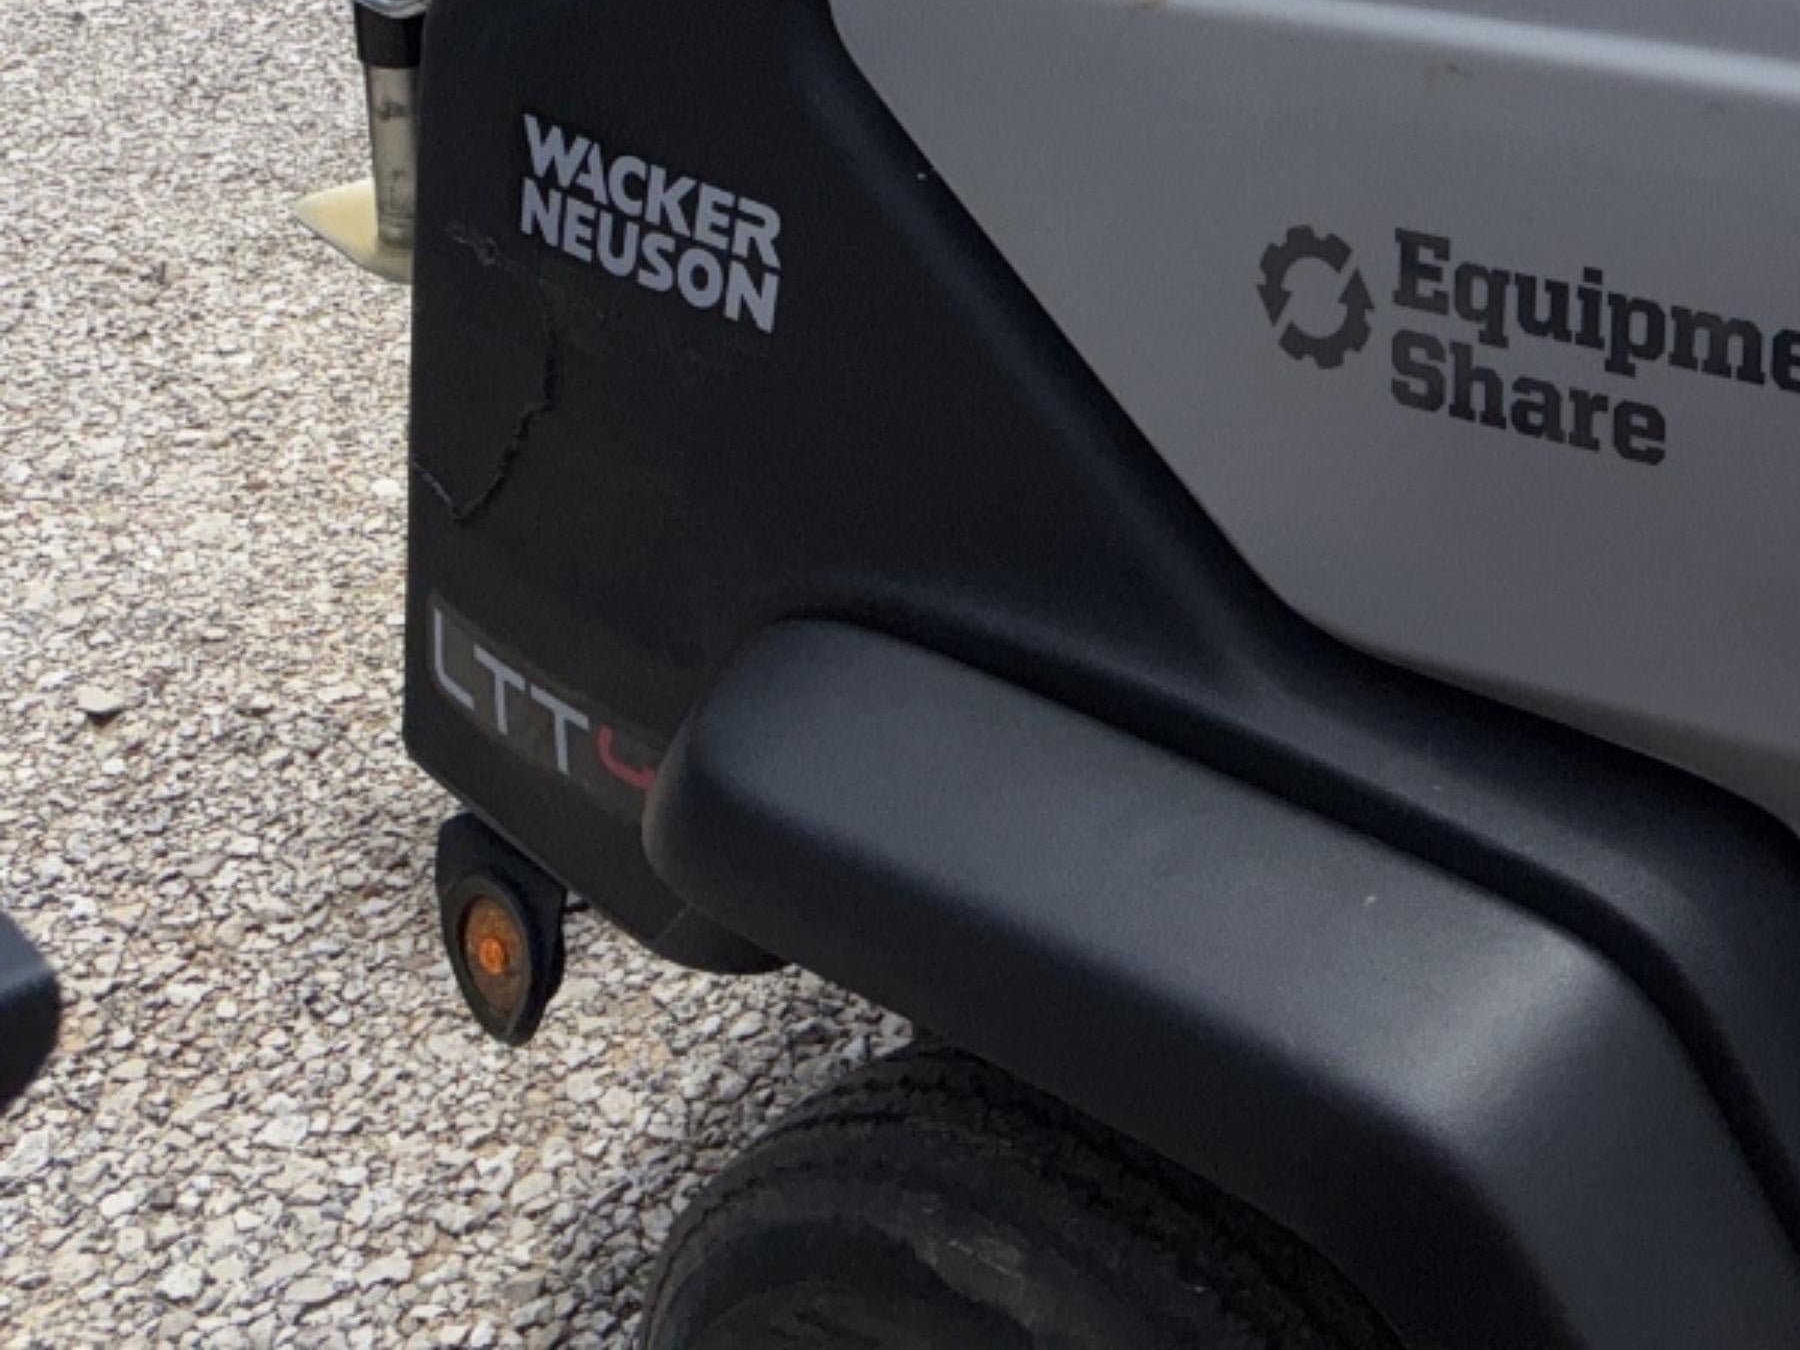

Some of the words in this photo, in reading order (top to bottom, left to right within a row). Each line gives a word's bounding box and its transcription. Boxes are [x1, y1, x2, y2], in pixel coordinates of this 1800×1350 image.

[520, 176, 780, 334] NEUSON
[524, 112, 782, 270] WACKER
[1390, 328, 1666, 467] Share
